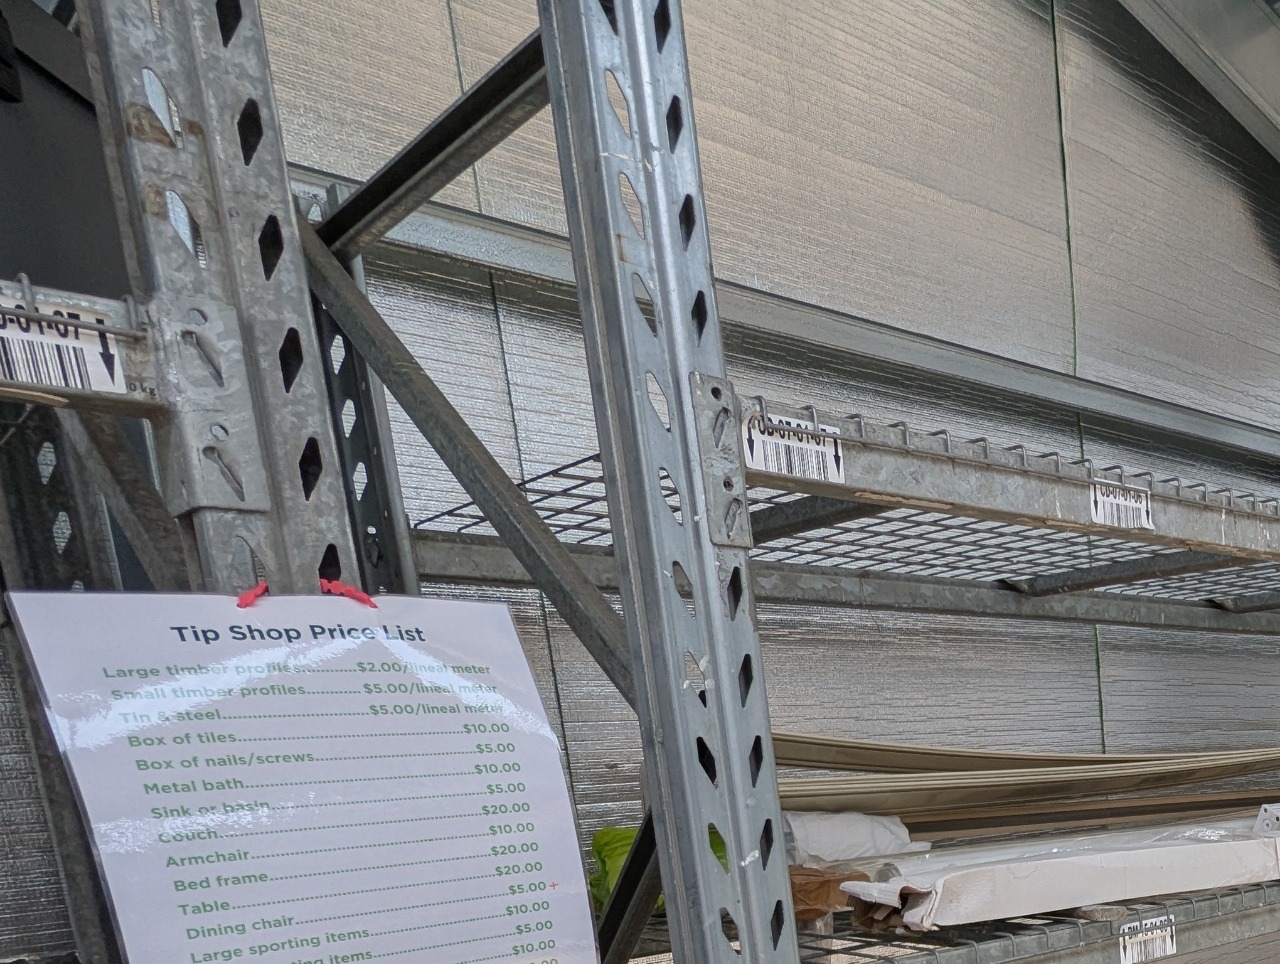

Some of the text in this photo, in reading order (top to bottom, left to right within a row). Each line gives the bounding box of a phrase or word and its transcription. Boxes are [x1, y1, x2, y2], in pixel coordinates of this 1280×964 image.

[170, 624, 426, 645] Tip Shop Price List
[102, 666, 161, 679] Large
[166, 665, 228, 676] timber
[452, 664, 491, 674] meter
[111, 689, 167, 700] Small
[171, 687, 235, 699] timber
[458, 684, 497, 694] meter
[158, 711, 172, 723] &
[128, 736, 166, 747] Box
[172, 733, 192, 745] of
[462, 723, 510, 735] $10.00
[135, 759, 174, 771] Box
[180, 756, 200, 768] of
[475, 742, 516, 754] $5.00
[143, 780, 198, 795] Metal
[474, 762, 521, 774] $10.00
[150, 804, 191, 819] Sink
[486, 783, 526, 795] $5.00
[481, 802, 531, 816] $20.00
[488, 822, 535, 836] $10.00
[173, 877, 211, 892] Bed
[490, 842, 539, 856] $20.00
[494, 861, 543, 877] $20.00
[186, 923, 247, 940] Dining
[508, 881, 547, 895] $5.00
[190, 948, 244, 964] Large
[248, 934, 321, 958] sporting
[505, 900, 550, 916] $10.00
[515, 920, 553, 935] $5.00
[512, 939, 556, 956] $10.00
